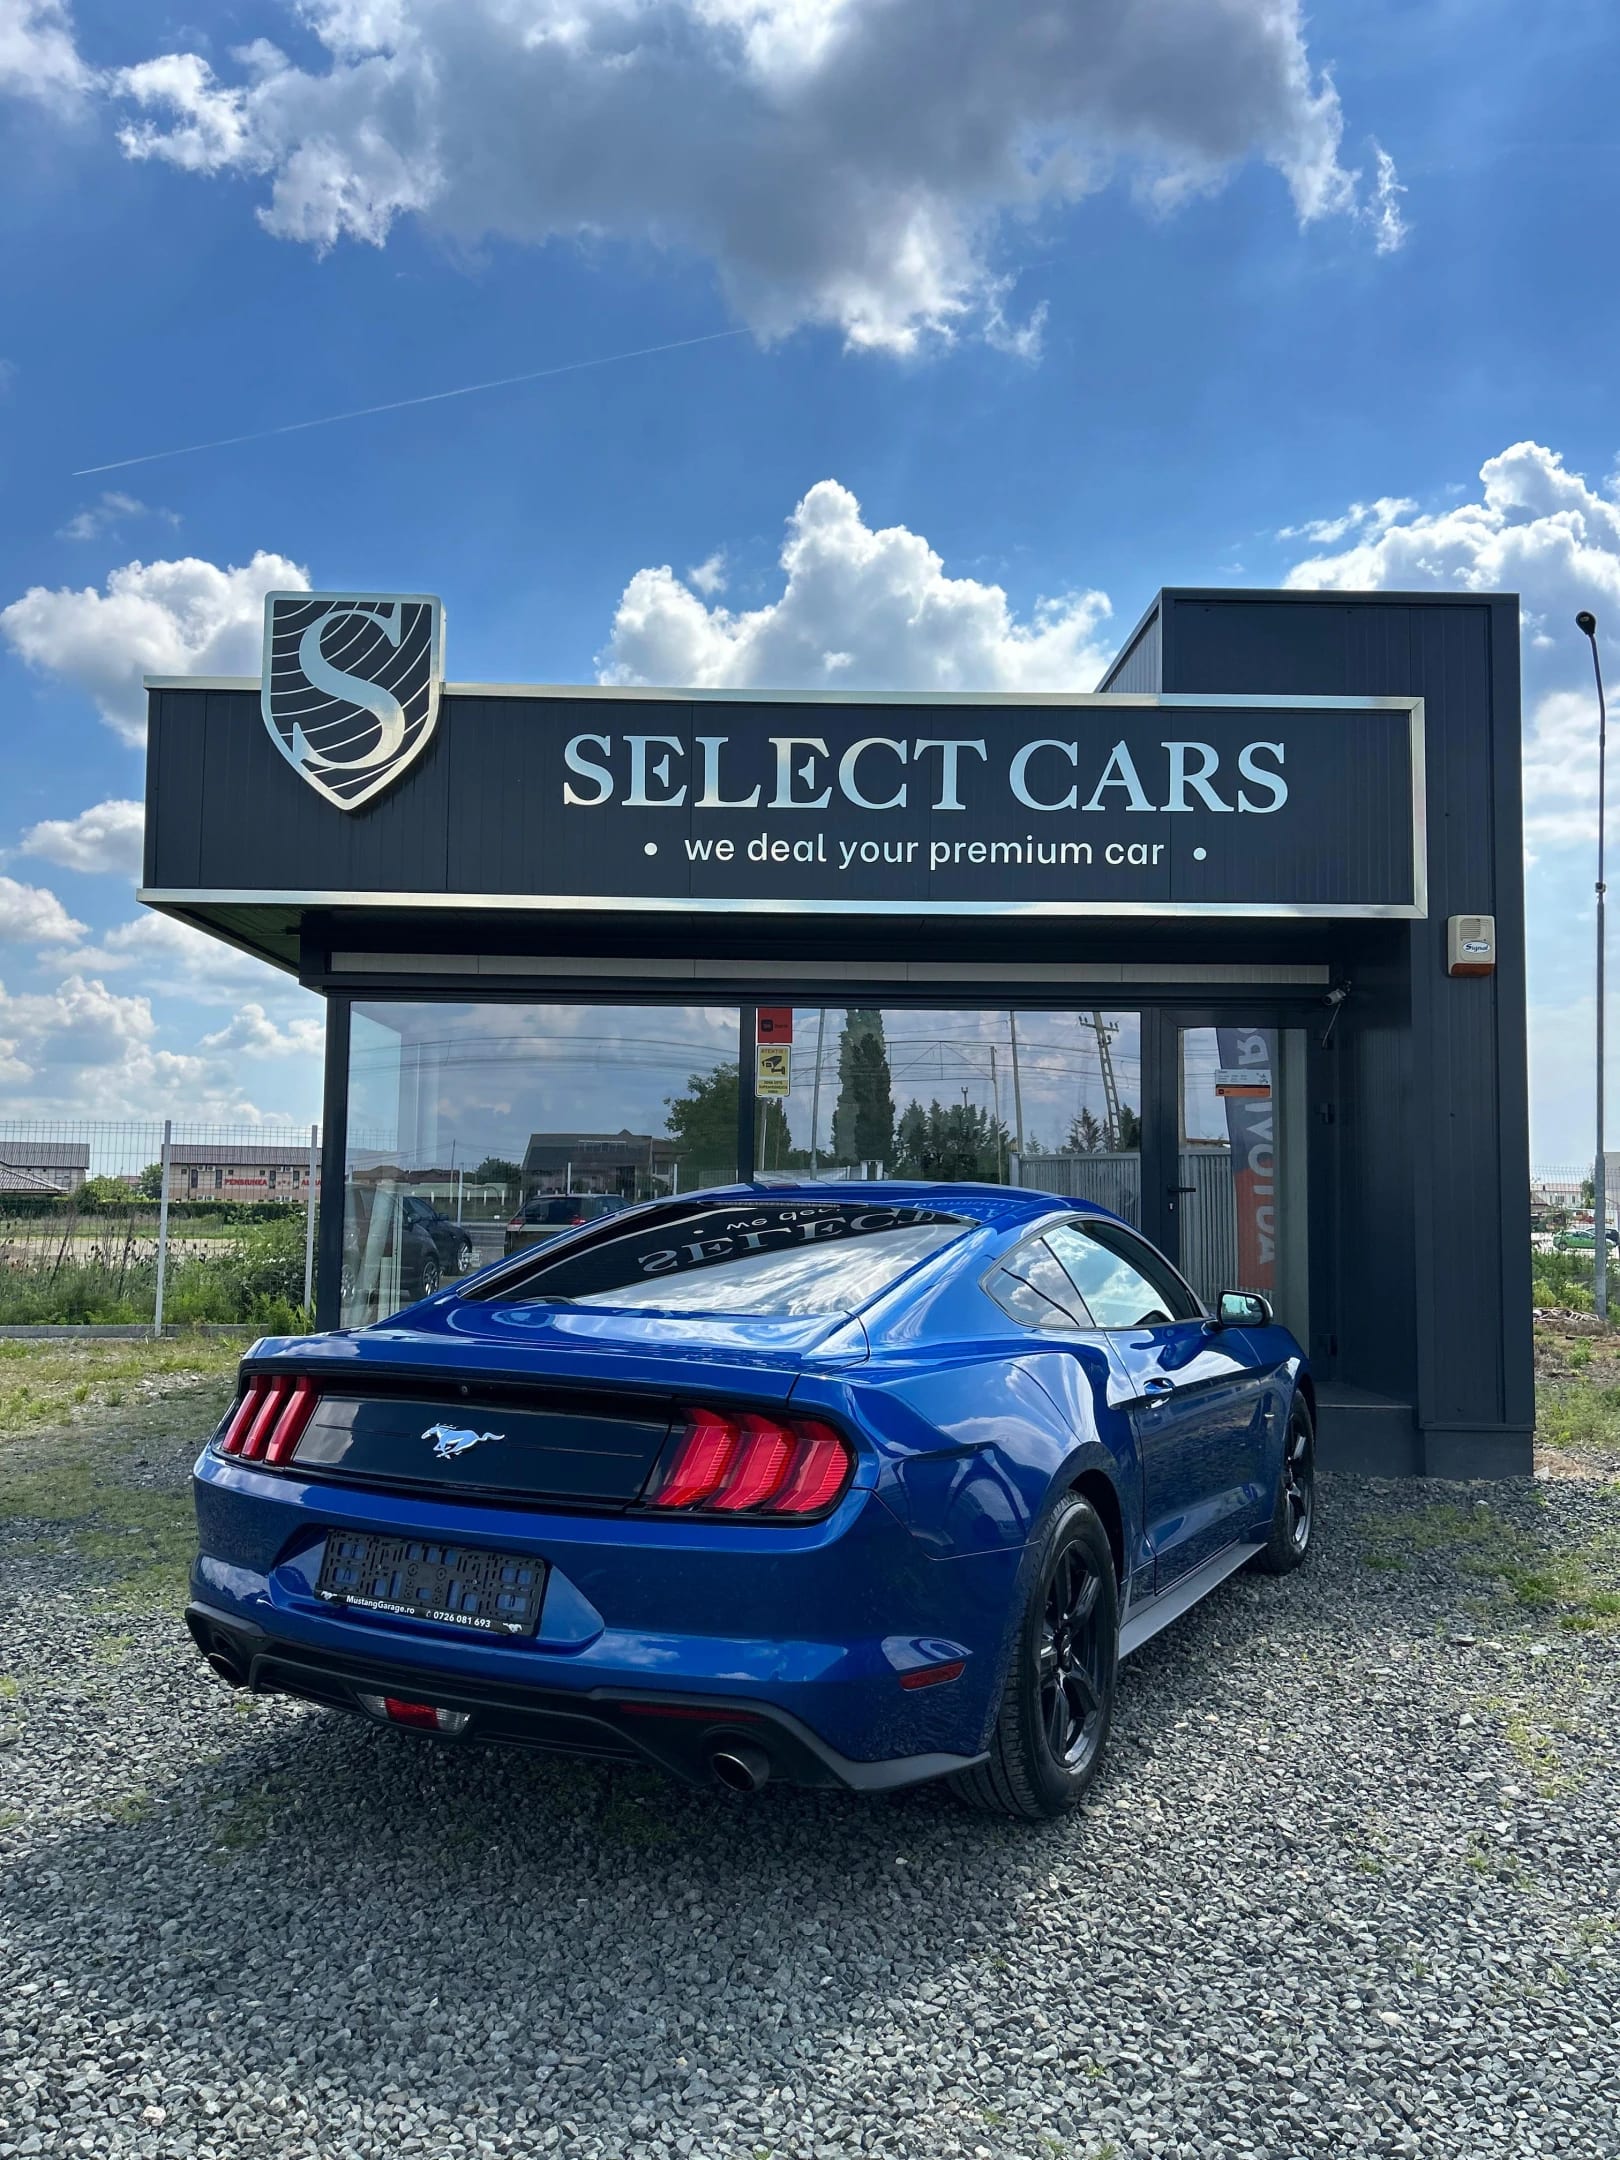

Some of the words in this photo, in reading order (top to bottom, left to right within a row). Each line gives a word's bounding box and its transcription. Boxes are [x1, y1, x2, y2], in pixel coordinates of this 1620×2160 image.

[563, 733, 988, 810] SELECT
[1009, 739, 1289, 814] CARS
[684, 839, 735, 861] we
[747, 832, 827, 862] deal
[838, 841, 919, 870] your
[930, 834, 1093, 871] premium
[1104, 843, 1165, 865] car
[224, 1178, 268, 1186] PENSIUNEA
[346, 1595, 415, 1614] MustangGarage.ro
[433, 1611, 455, 1622] 0726
[456, 1615, 472, 1625] 081
[474, 1619, 491, 1628] 693
